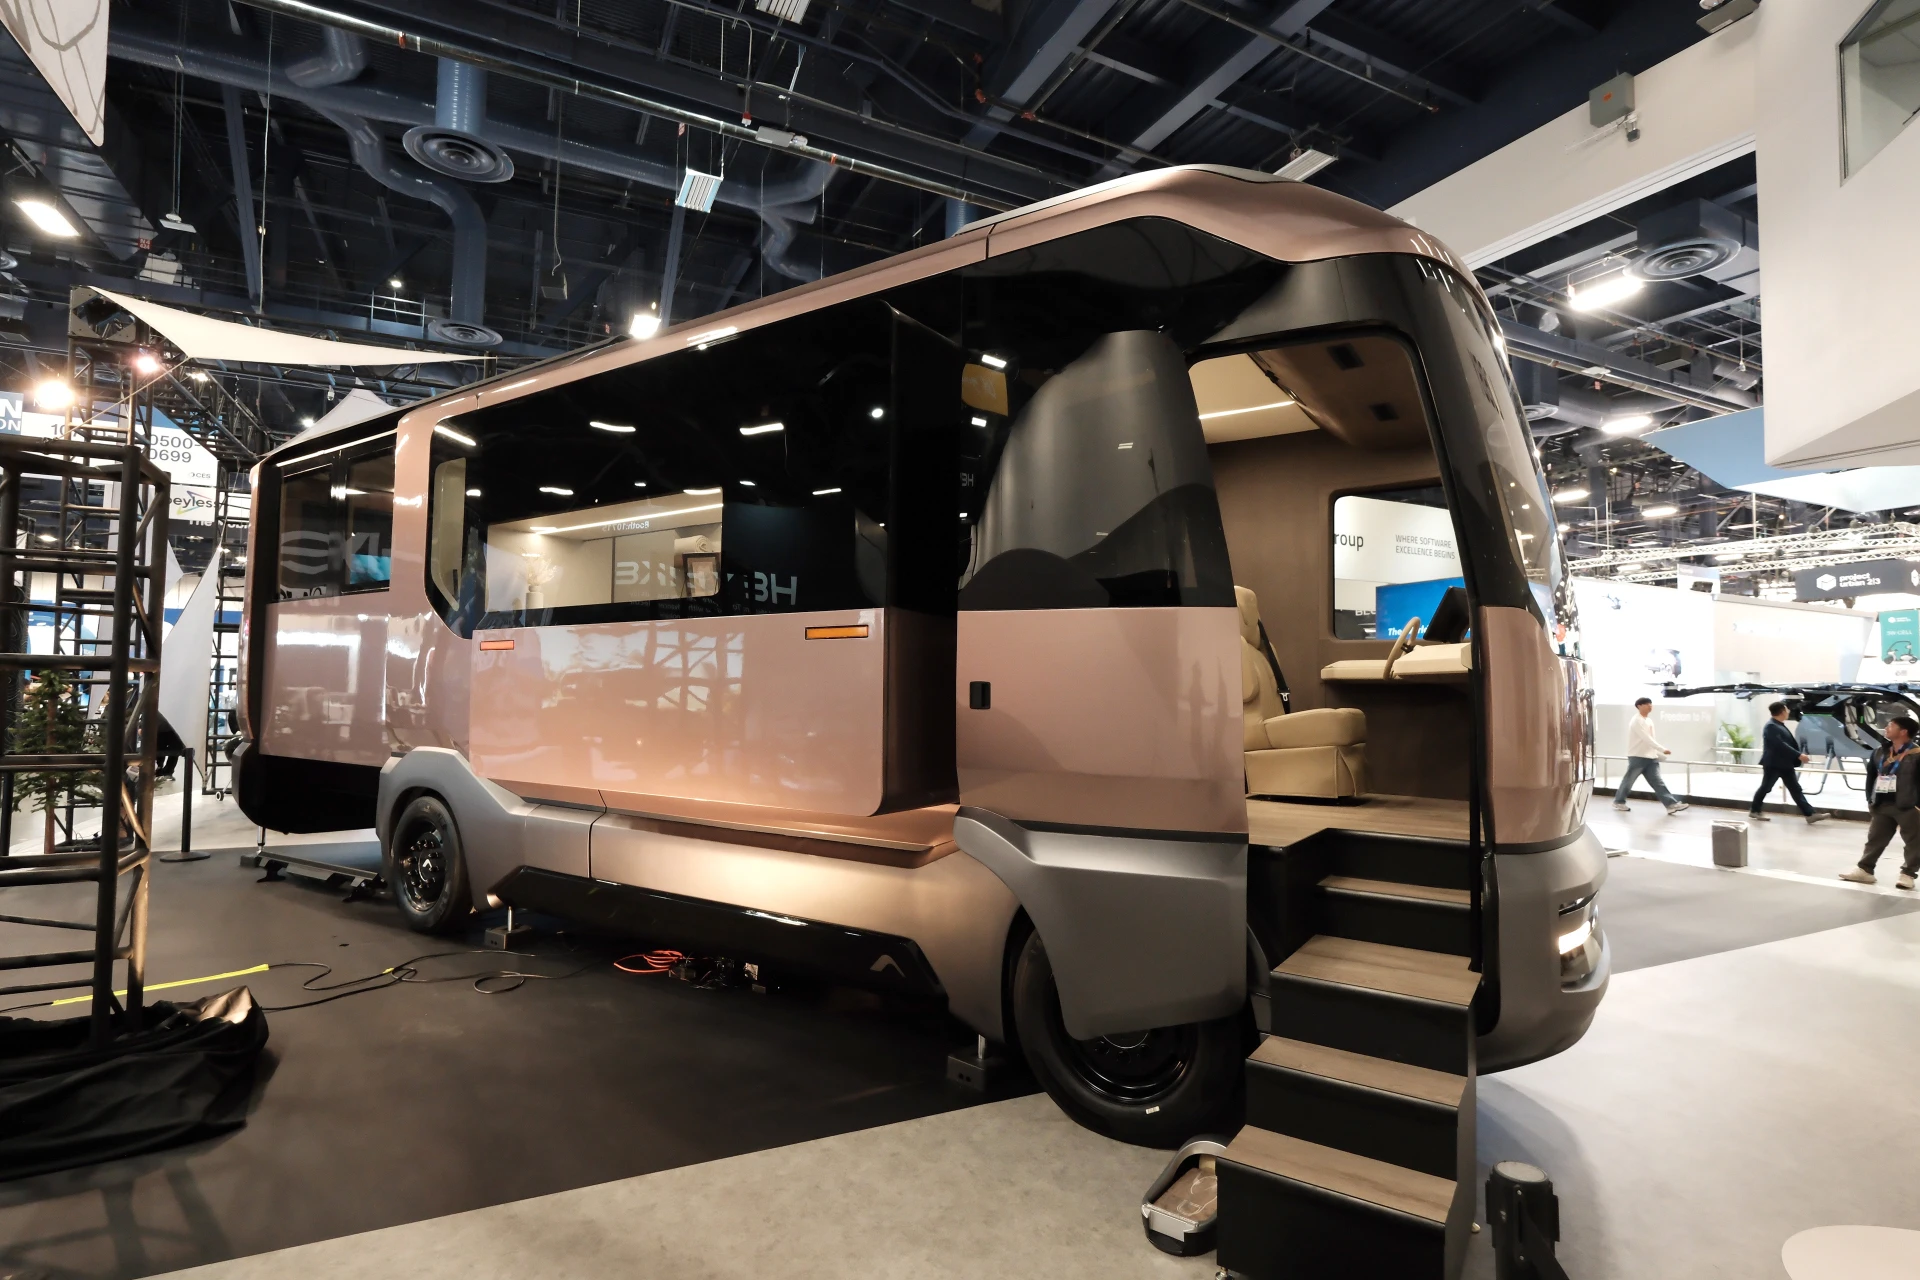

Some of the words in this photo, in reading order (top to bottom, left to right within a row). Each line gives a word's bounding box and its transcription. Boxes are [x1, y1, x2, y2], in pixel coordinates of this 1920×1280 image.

[169, 495, 217, 508] eyles
[1395, 534, 1418, 544] WHERE
[1420, 536, 1452, 549] SOFTWARE
[1395, 545, 1433, 557] EXCELLENCE
[1434, 548, 1456, 560] BEGINS
[1839, 572, 1871, 582] project
[1839, 580, 1866, 588] urban
[1388, 627, 1402, 636] The
[1660, 710, 1691, 722] Freedom
[1692, 712, 1700, 722] to
[1701, 710, 1711, 724] Fly
